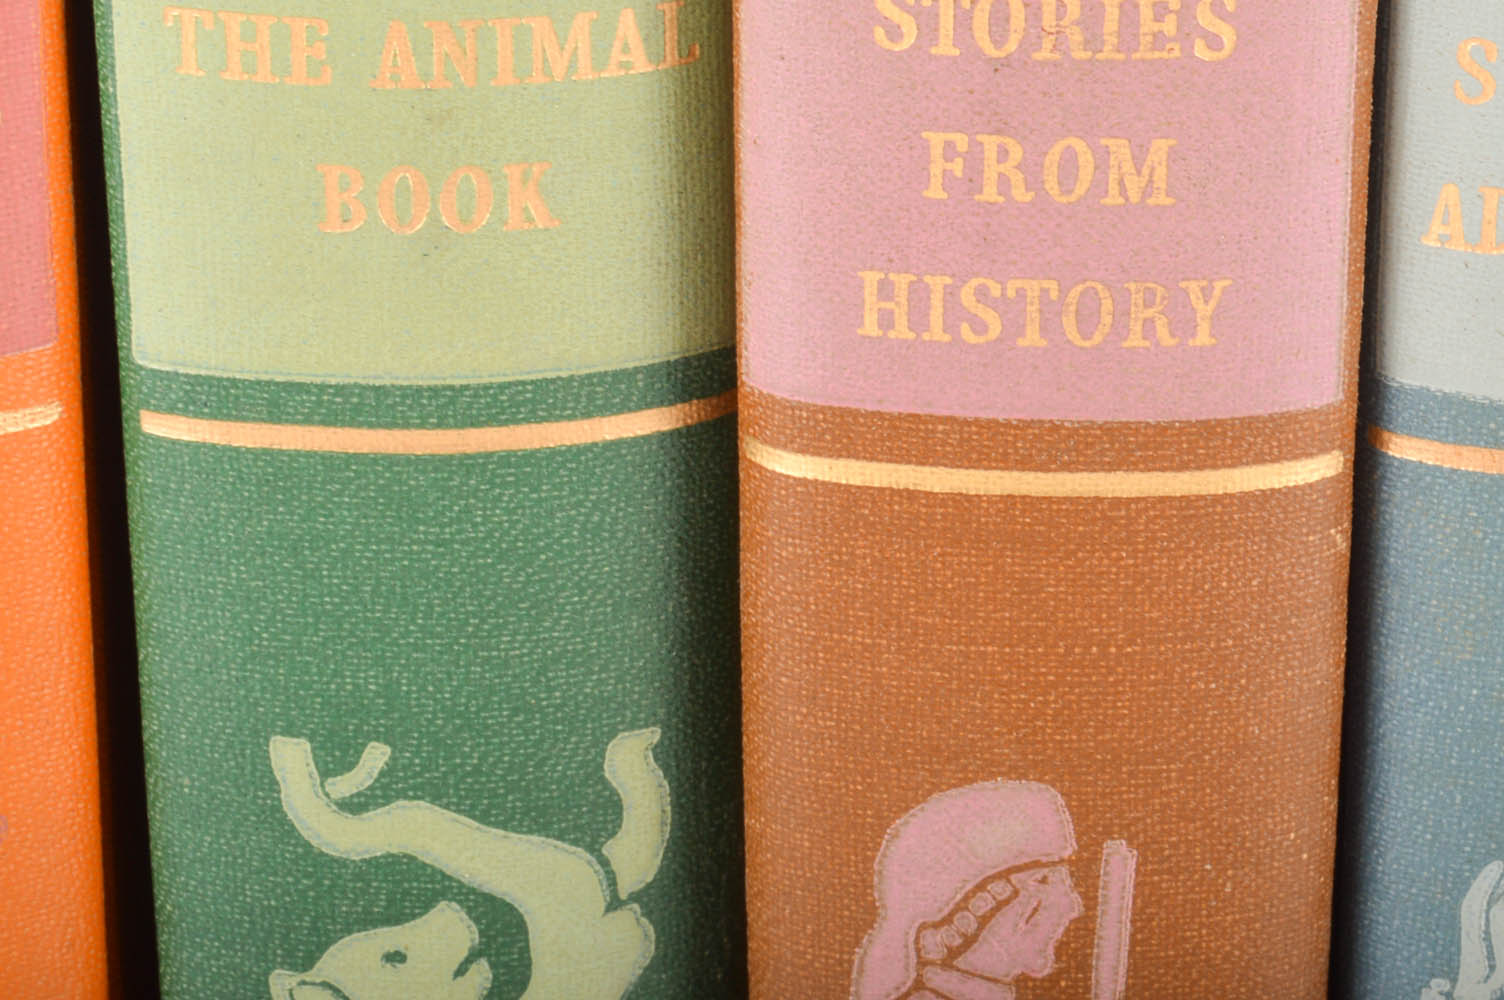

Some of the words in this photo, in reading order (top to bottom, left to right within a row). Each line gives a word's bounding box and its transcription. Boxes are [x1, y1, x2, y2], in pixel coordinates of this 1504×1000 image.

[162, 4, 333, 87] THE
[368, 0, 702, 91] ANIMAL
[316, 161, 563, 235] BOOK
[920, 130, 1179, 206] FROM
[855, 269, 1234, 348] HISTORY
